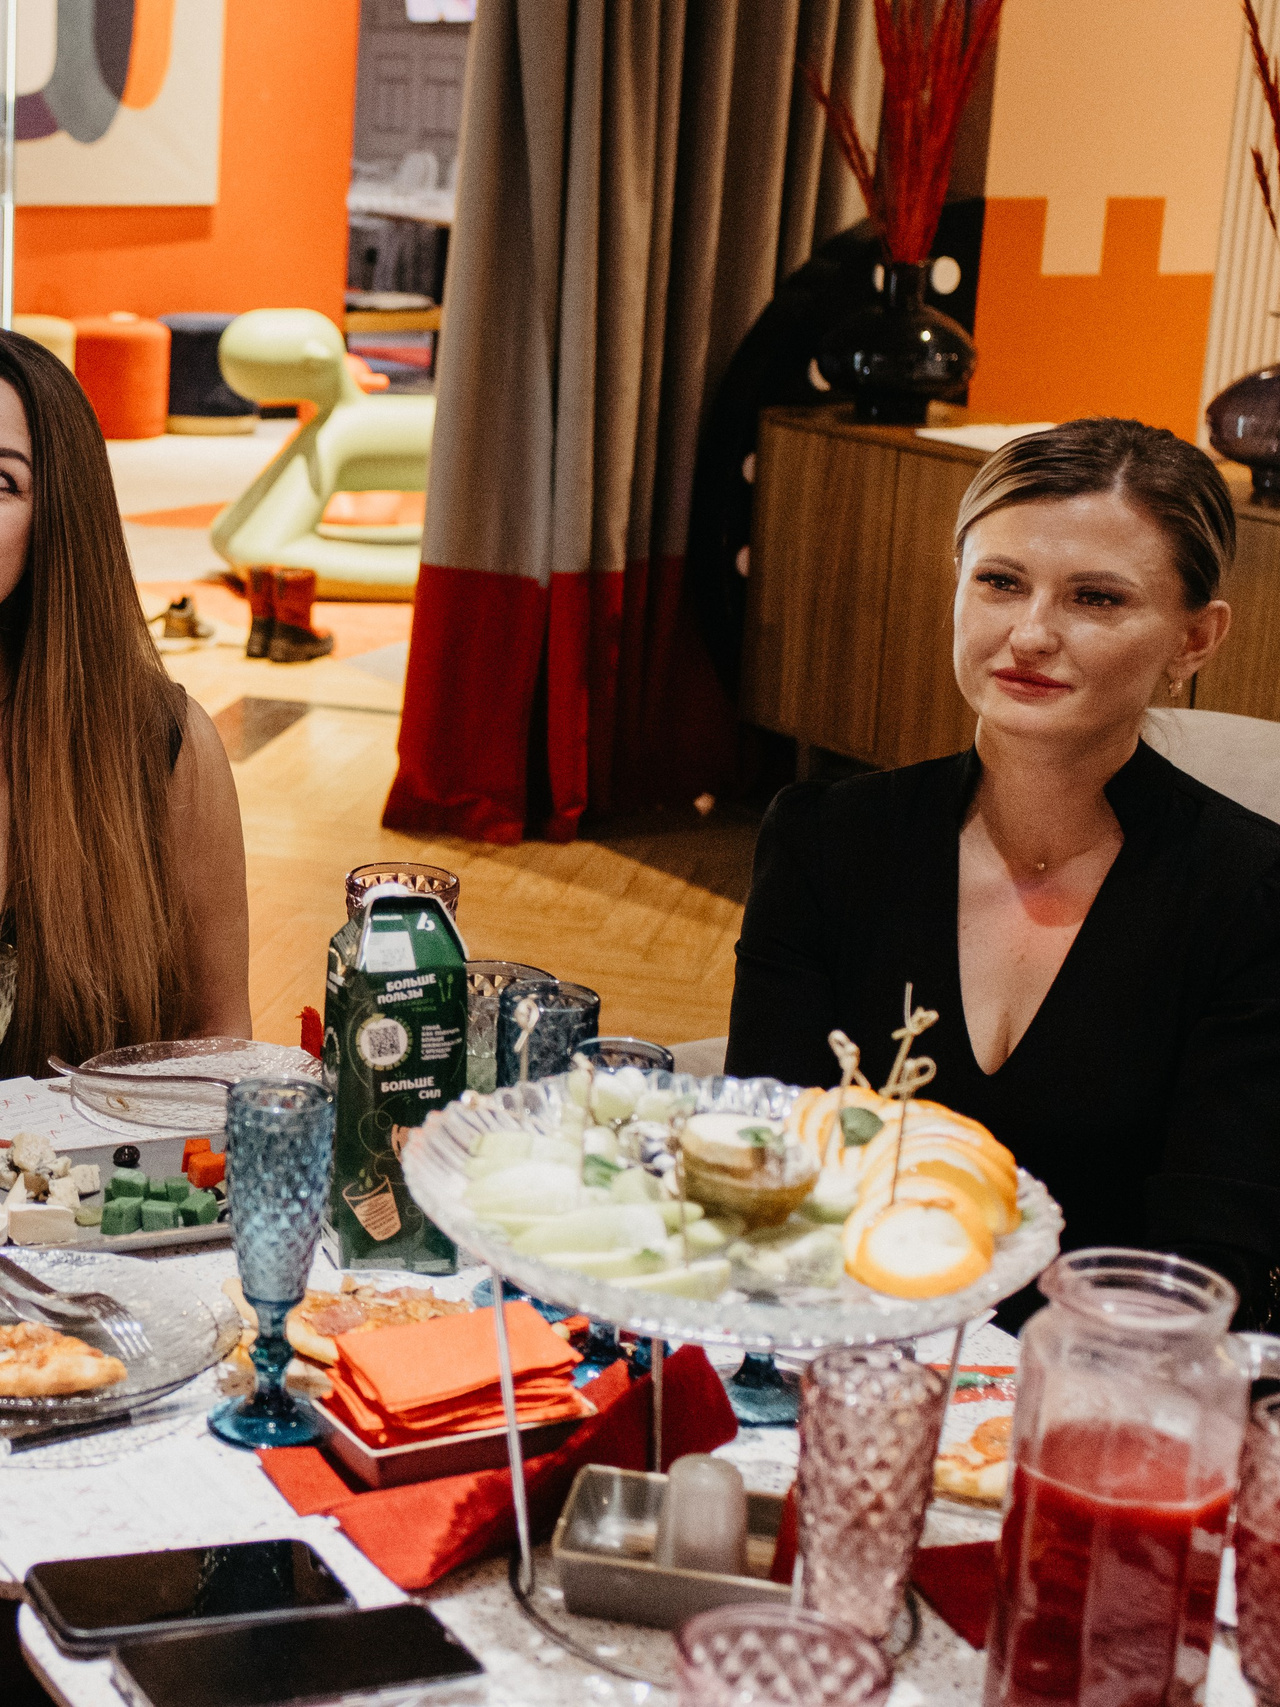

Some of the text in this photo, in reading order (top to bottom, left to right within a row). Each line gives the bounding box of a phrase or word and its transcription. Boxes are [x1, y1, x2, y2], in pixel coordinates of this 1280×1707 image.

[386, 973, 437, 992] БОЛЬШЕ
[377, 988, 424, 1005] ПОЛЬЗЫ
[380, 1076, 435, 1093] БОЛЬШЕ
[417, 1089, 442, 1099] СИЛ
